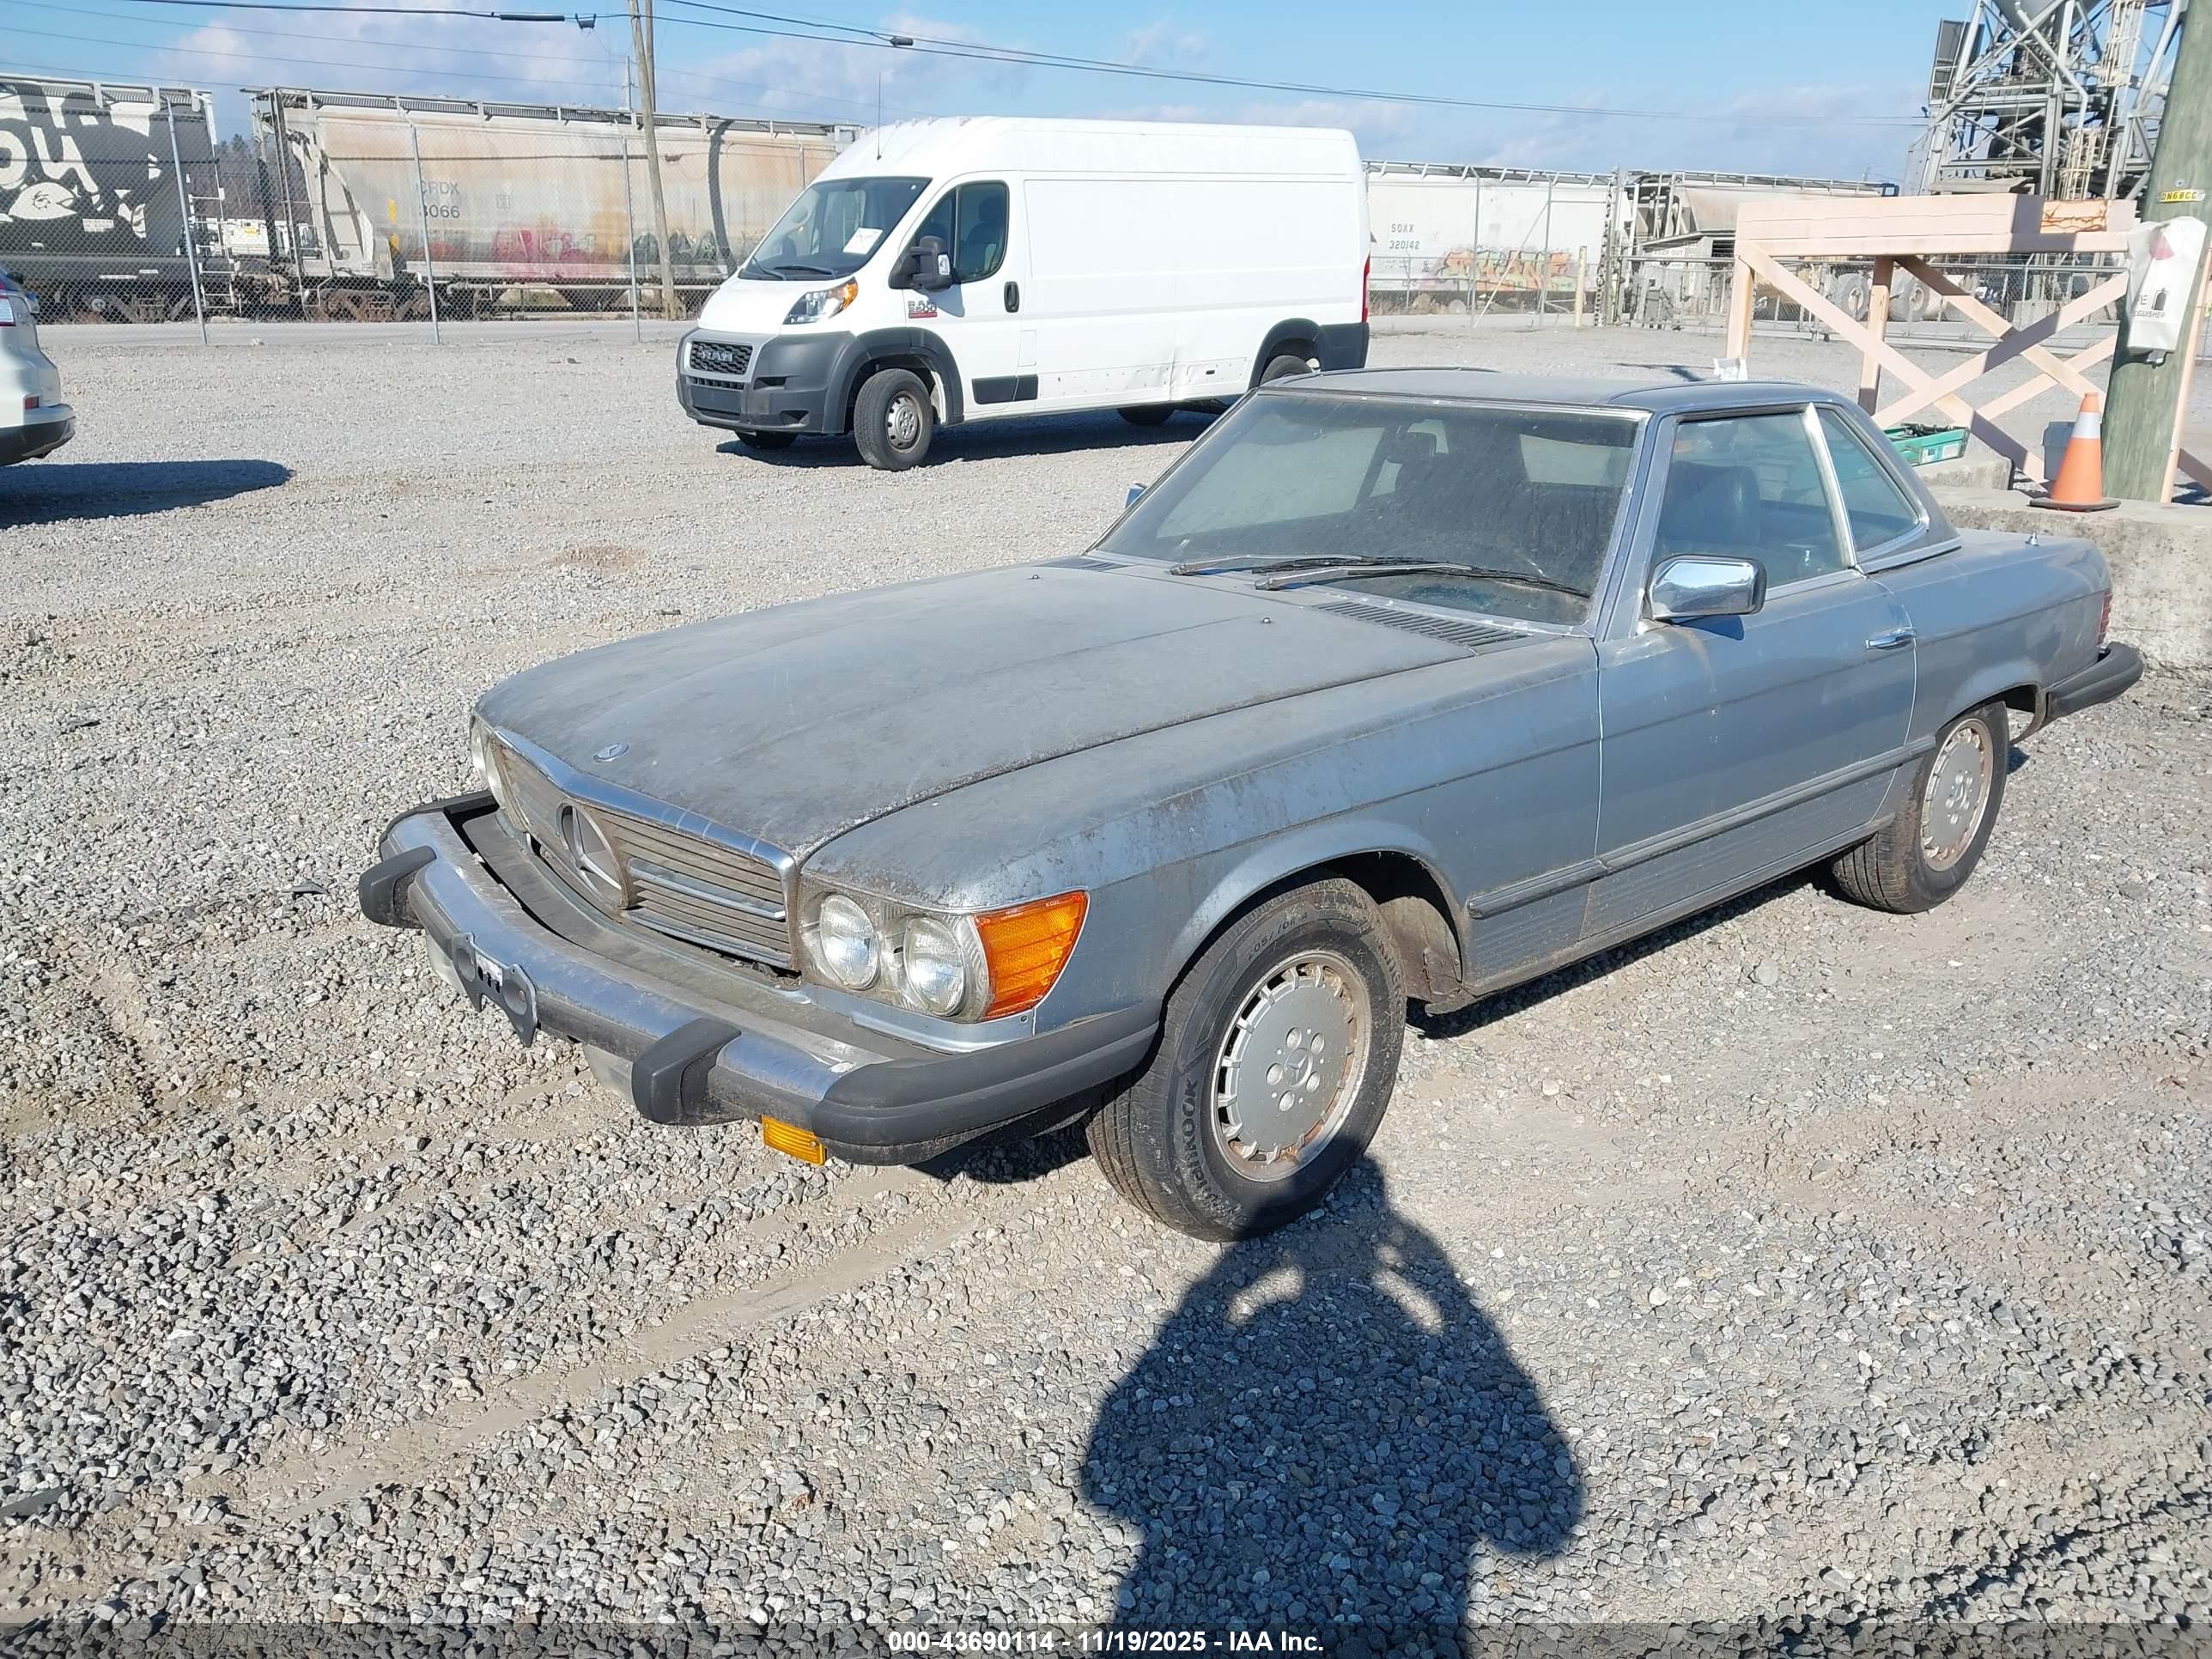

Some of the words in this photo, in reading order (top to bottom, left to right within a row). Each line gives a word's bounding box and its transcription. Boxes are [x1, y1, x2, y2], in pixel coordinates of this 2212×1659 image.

[1390, 223, 1414, 233] SOXX
[1389, 240, 1420, 249] 320142
[700, 349, 733, 362] RAM
